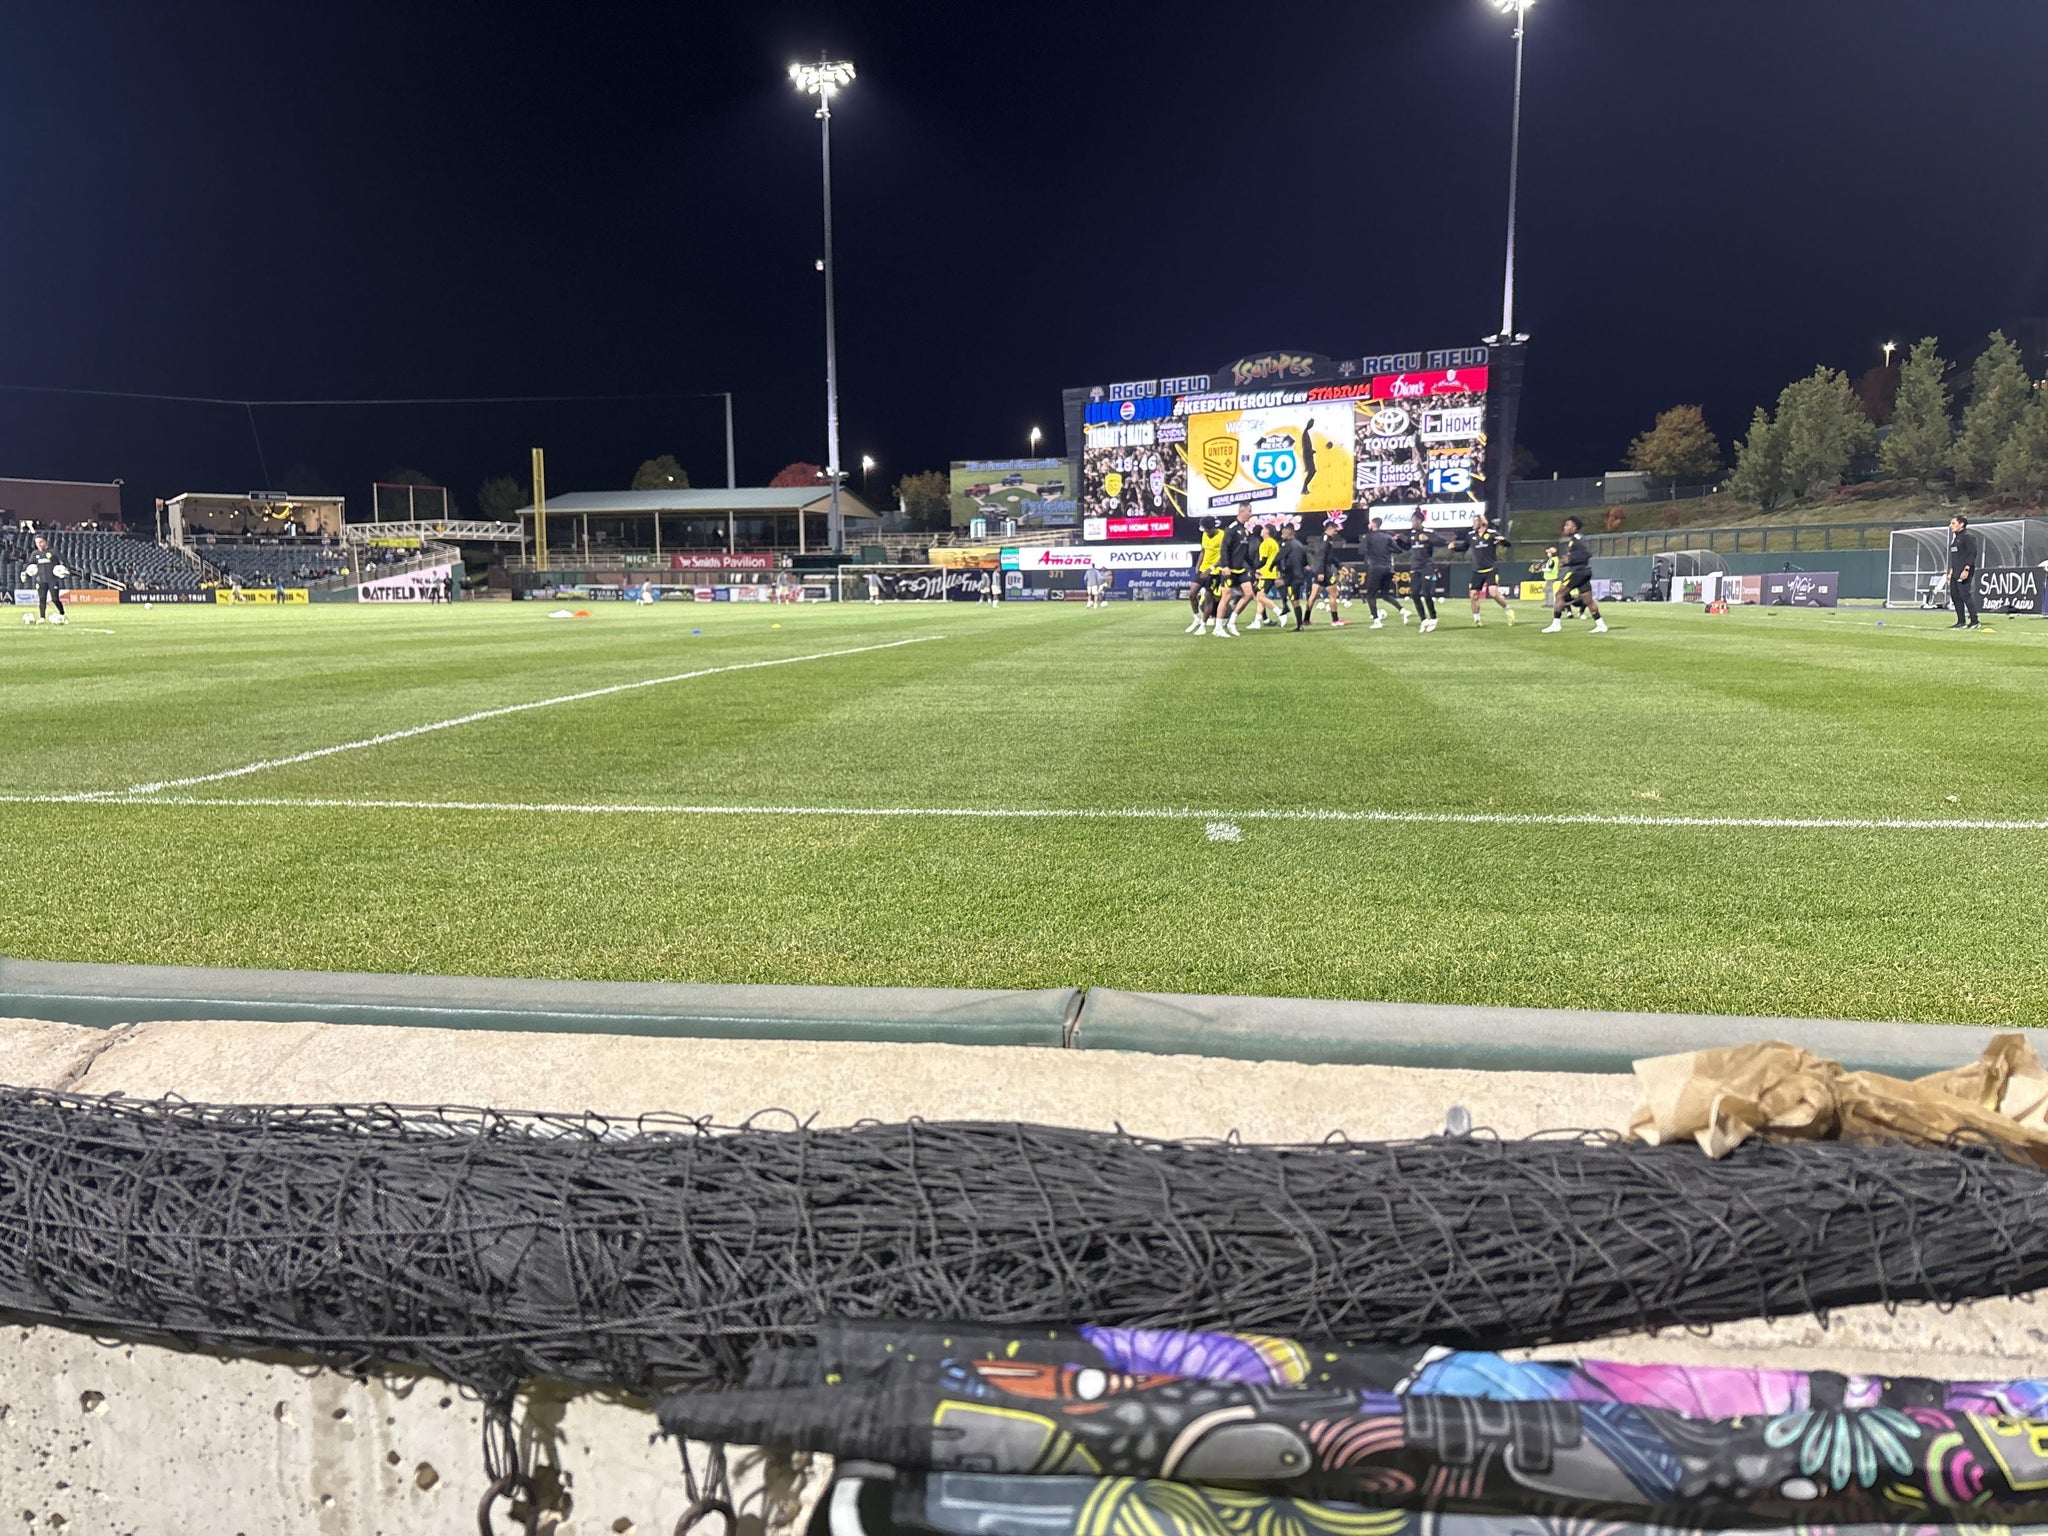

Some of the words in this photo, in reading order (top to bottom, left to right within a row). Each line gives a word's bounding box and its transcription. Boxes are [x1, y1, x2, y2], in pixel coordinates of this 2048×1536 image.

[1363, 352, 1422, 375] RGCU
[1427, 347, 1488, 369] FIELD
[1109, 380, 1157, 401] RGCU
[1160, 375, 1210, 396] FIELD
[1308, 384, 1371, 399] STADIUM
[1445, 416, 1478, 433] HOME
[1363, 435, 1415, 450] TOYOTA
[1208, 445, 1233, 456] UNITED
[1257, 454, 1294, 479] 50
[1382, 463, 1418, 474] SOMOS
[1429, 459, 1470, 469] NEWS
[1382, 472, 1420, 482] UNIDOS
[1429, 468, 1470, 492] 13
[1431, 510, 1477, 521] ULTRA
[1109, 523, 1128, 532] YOUR
[1129, 522, 1149, 531] HOME
[1150, 521, 1170, 530] TEAM
[723, 557, 765, 567] Pavilion
[1038, 551, 1092, 565] Amana
[1110, 552, 1161, 562] PAYDAY
[962, 580, 983, 592] TIM
[1979, 571, 2037, 595] SANDIA
[131, 594, 150, 602] NEW
[150, 594, 178, 602] MEXICO
[188, 594, 206, 602] TRUE
[362, 586, 415, 600] OATFIELD
